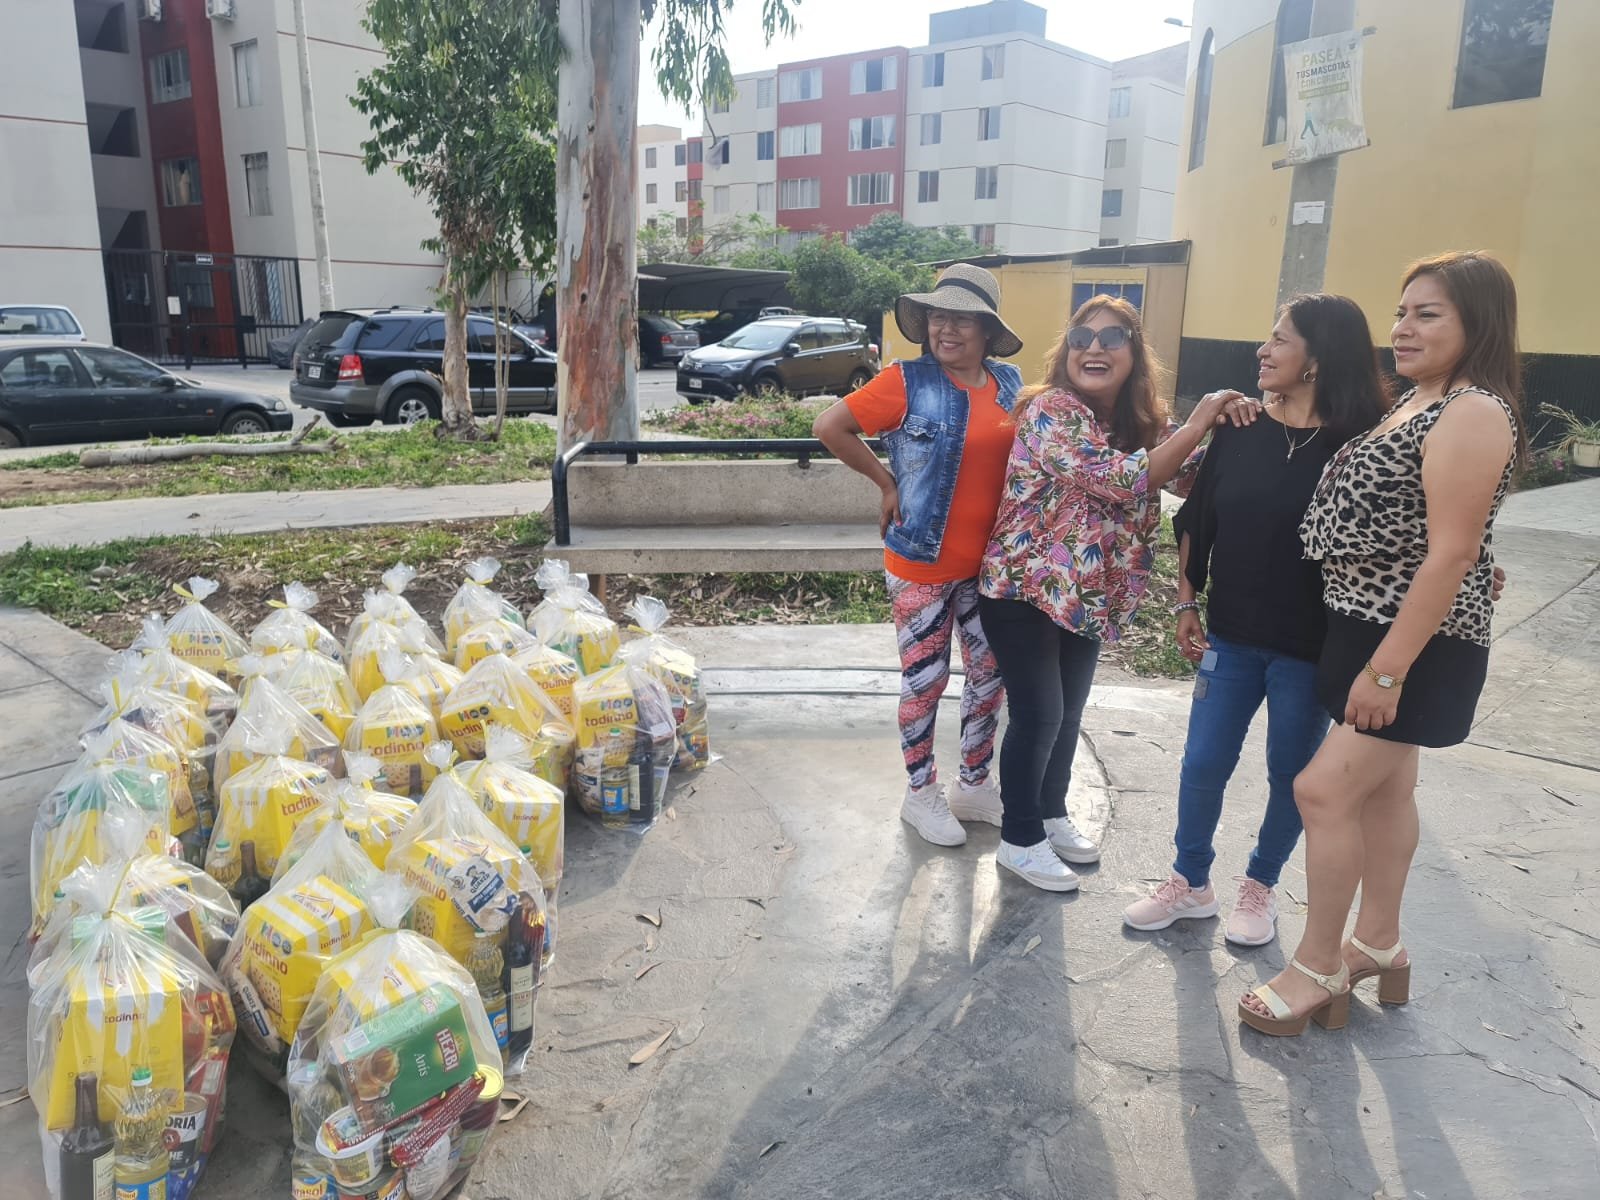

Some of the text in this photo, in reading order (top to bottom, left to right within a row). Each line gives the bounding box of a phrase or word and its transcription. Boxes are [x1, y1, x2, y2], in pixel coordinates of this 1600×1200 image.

[1302, 48, 1343, 66] PASEA
[171, 646, 222, 657] todinno
[585, 710, 634, 728] todinno
[436, 1027, 460, 1073] HERBI
[164, 1115, 196, 1130] ORIA
